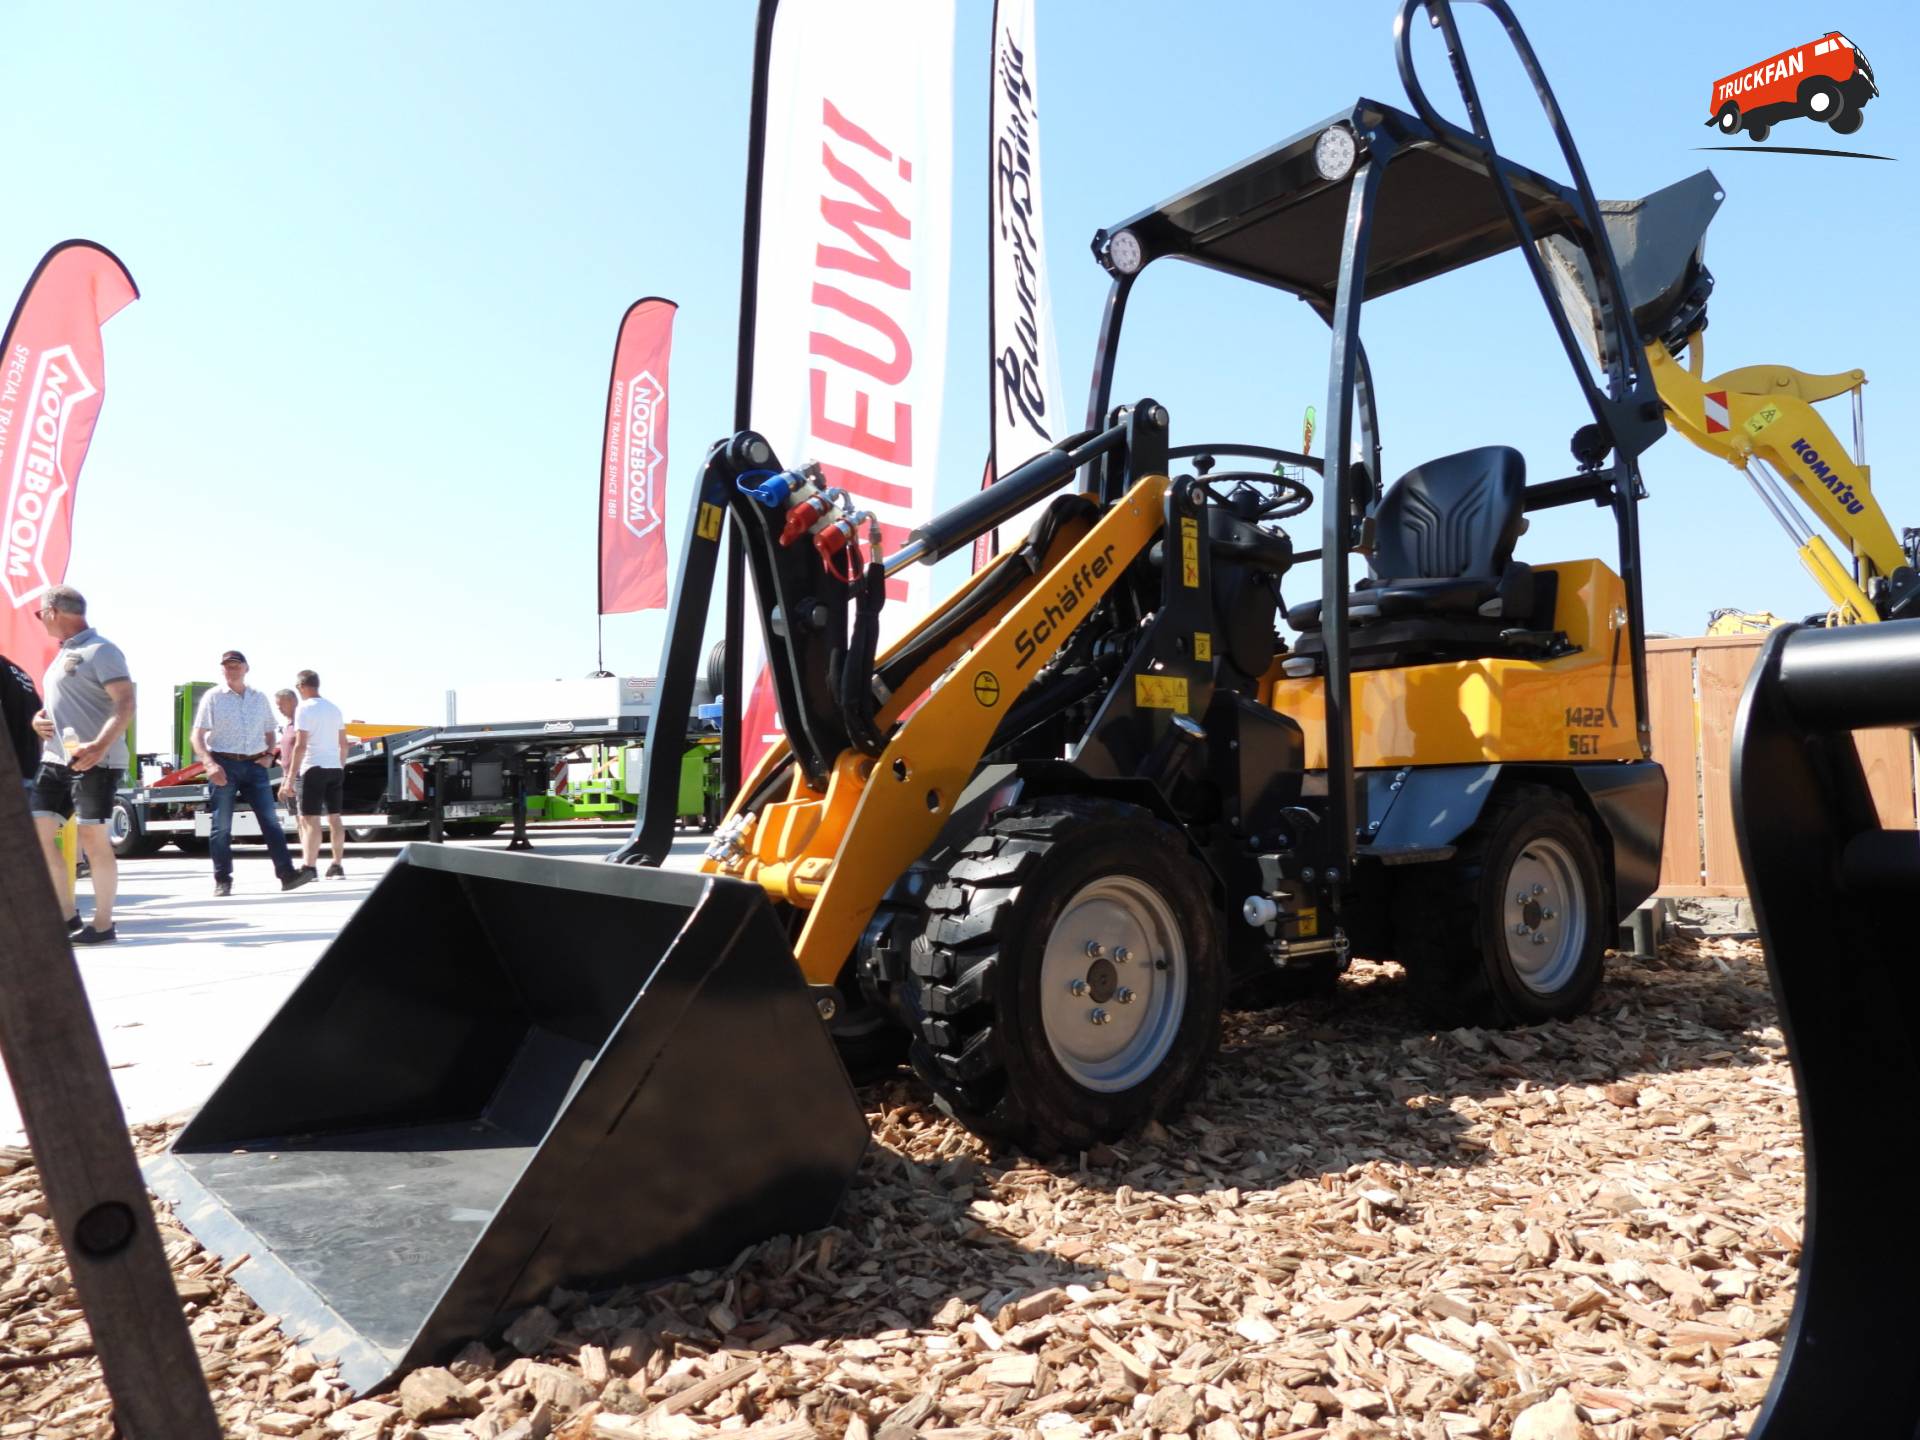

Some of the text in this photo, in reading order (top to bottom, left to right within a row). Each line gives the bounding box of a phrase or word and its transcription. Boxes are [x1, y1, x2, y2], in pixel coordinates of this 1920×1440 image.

[2, 343, 30, 403] SPECIAL
[613, 379, 625, 417] SPECIAL
[8, 362, 69, 577] NOOTEBOOM
[608, 464, 618, 496] SINCE
[629, 386, 651, 521] NOOTEBOOM
[1790, 437, 1865, 515] KOMATSU
[1014, 543, 1115, 671] Schäffer
[1565, 706, 1605, 728] 1422
[1568, 734, 1600, 755] SGT
